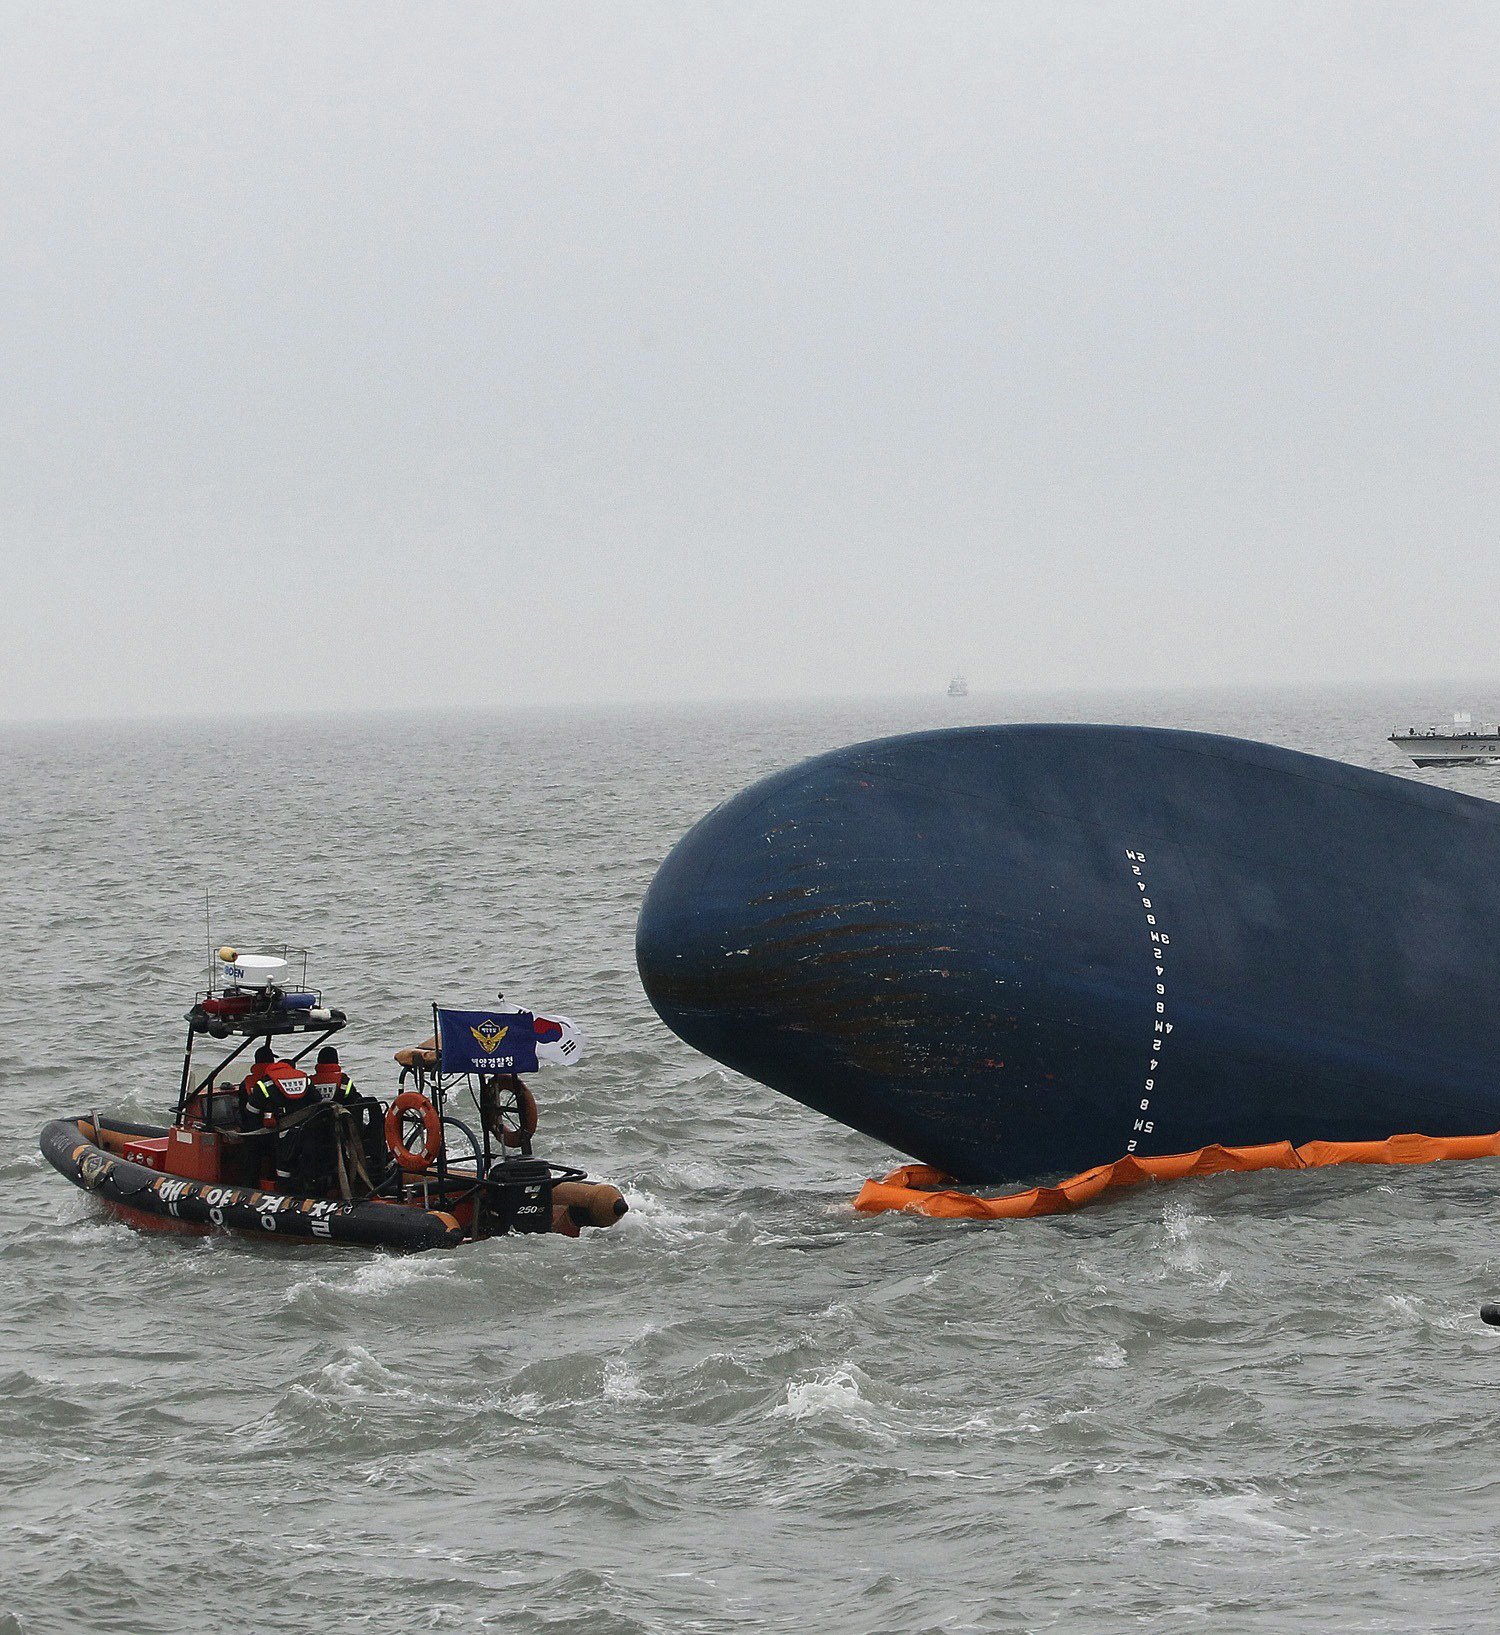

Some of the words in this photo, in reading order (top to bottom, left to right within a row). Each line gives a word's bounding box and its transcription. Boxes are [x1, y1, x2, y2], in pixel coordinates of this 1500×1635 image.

[1131, 865, 1141, 876] 2
[1137, 881, 1146, 891] 4
[1146, 914, 1156, 925] 8
[1153, 947, 1162, 959] 2
[1155, 965, 1164, 976] 4
[1156, 1002, 1165, 1013] 8
[1152, 1039, 1162, 1051] 2
[1150, 1058, 1159, 1070] 4
[1139, 1098, 1149, 1111] 8
[1127, 1139, 1138, 1152] 2
[158, 1180, 338, 1239] 해양경찰
